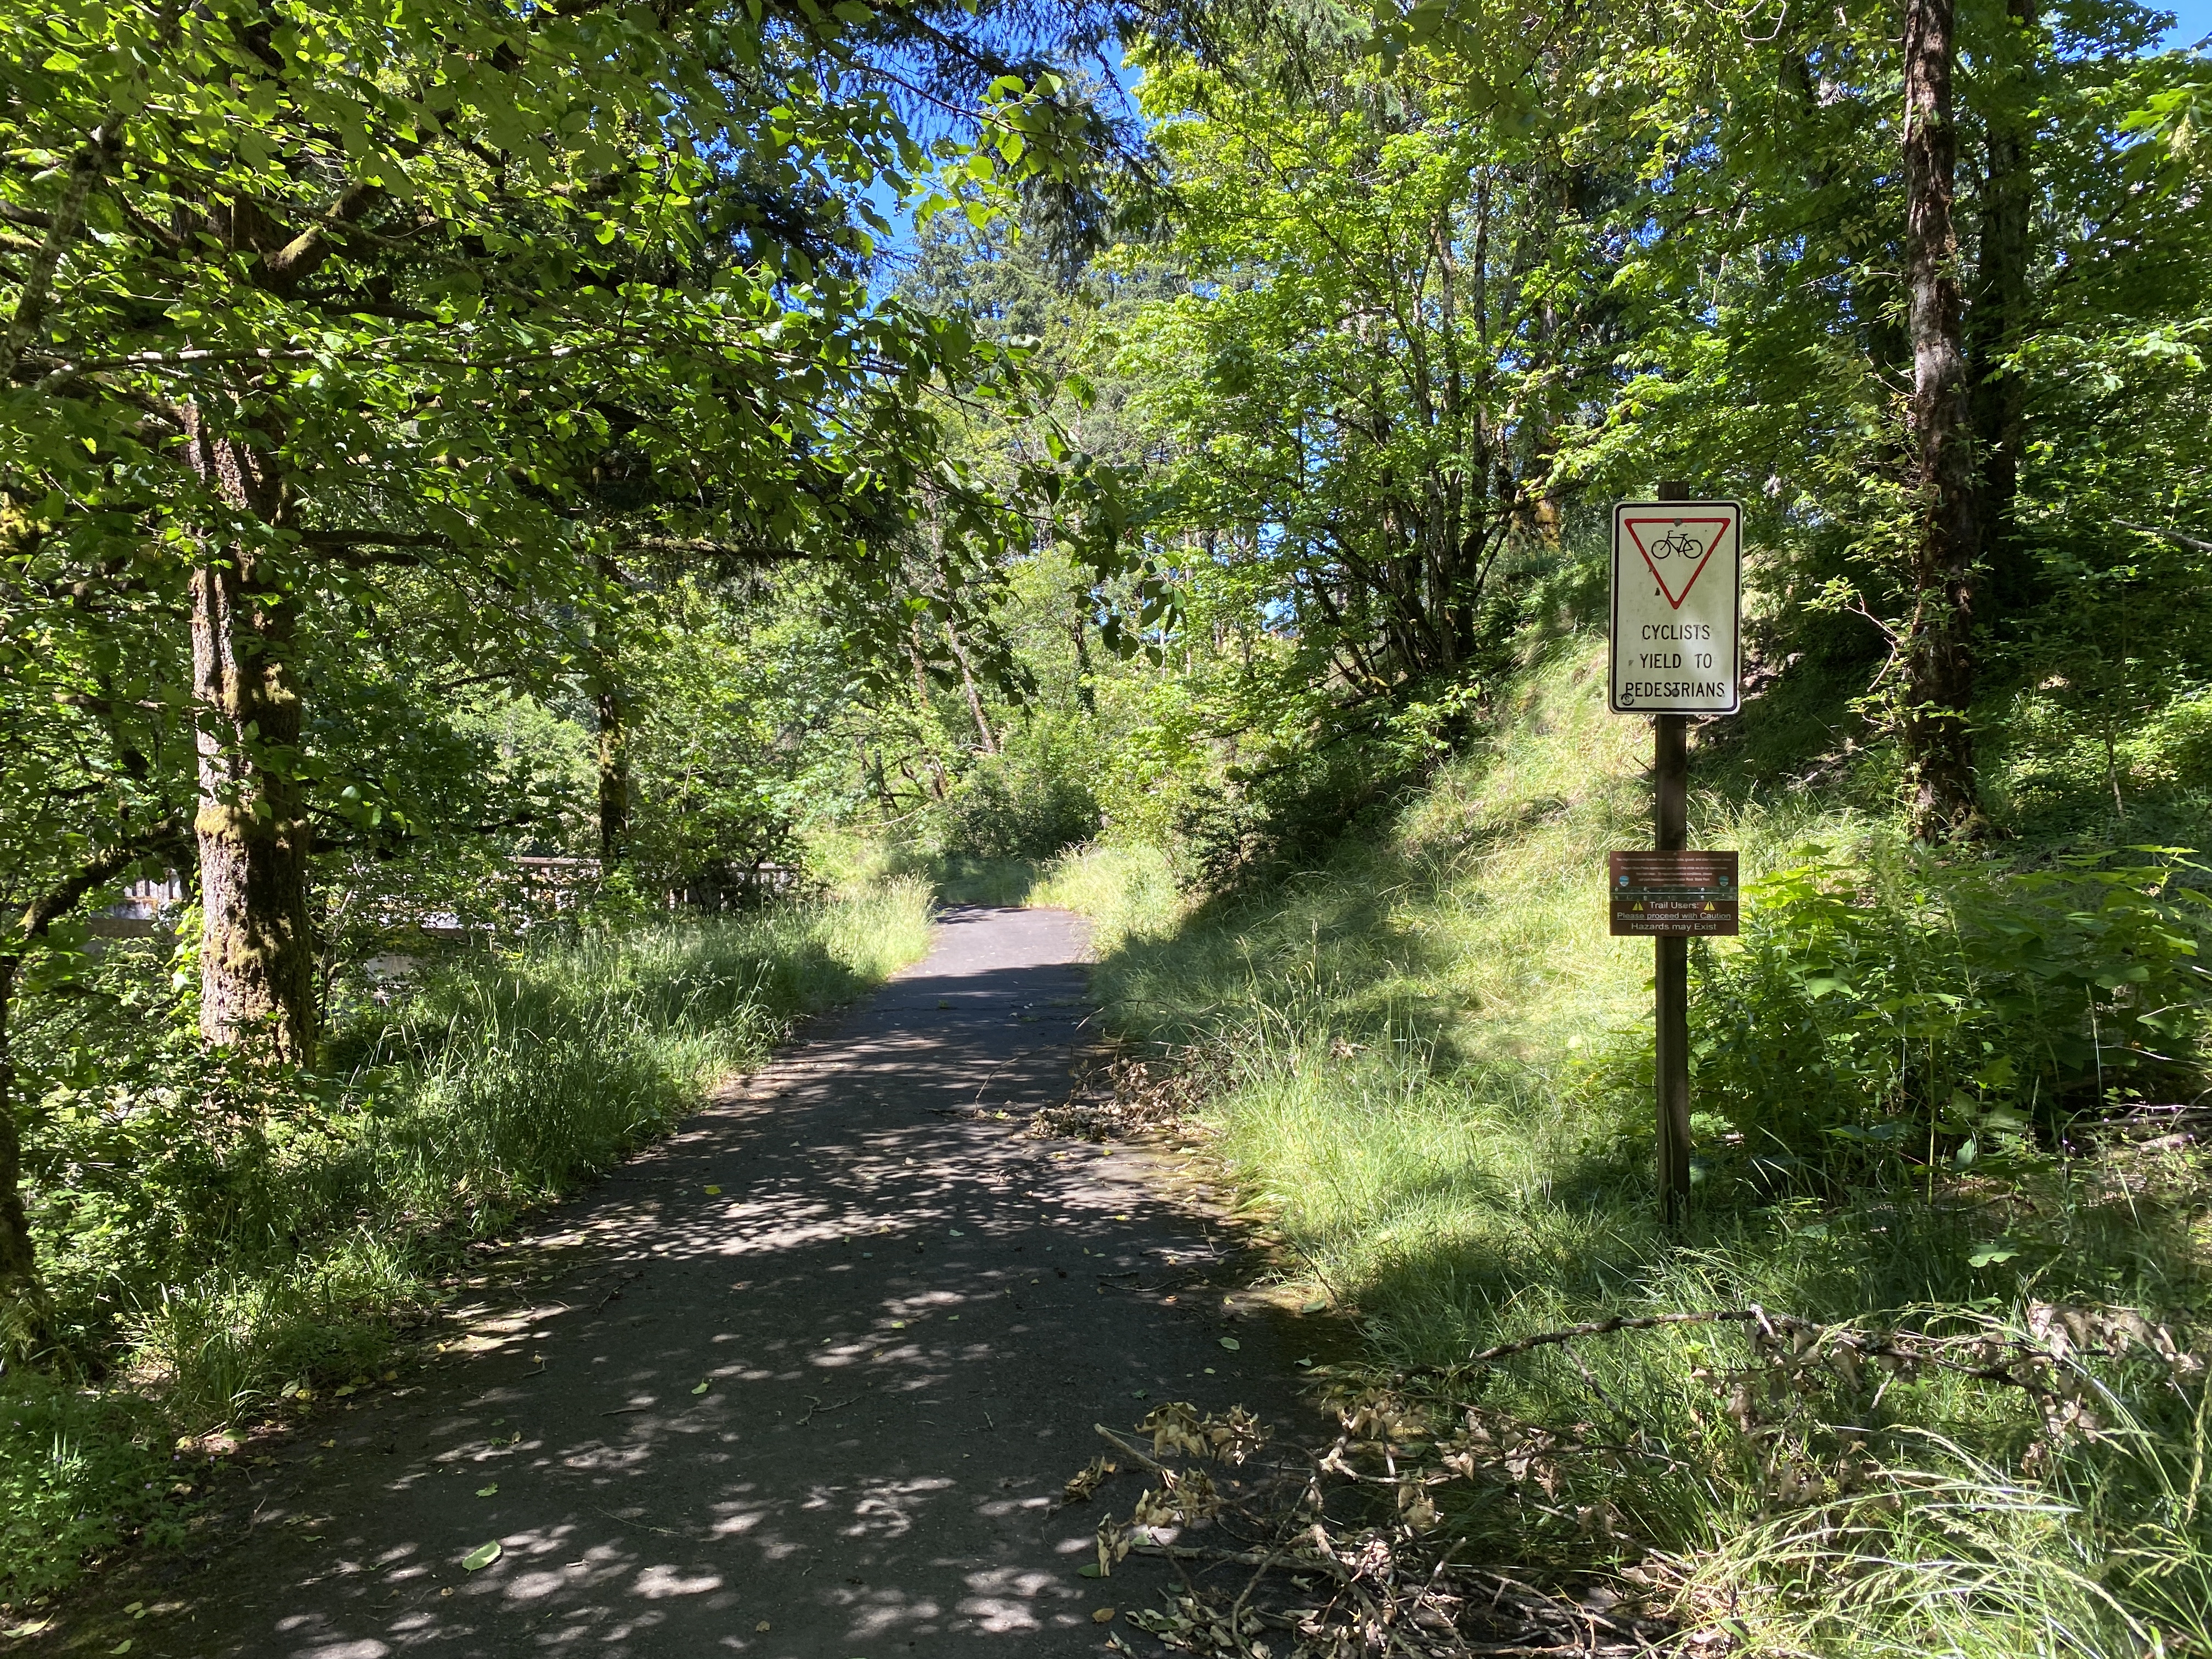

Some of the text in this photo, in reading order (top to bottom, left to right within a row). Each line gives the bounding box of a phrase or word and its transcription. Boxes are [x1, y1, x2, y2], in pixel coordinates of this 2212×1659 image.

[1642, 624, 1711, 640] CYCLISTS
[1639, 653, 1712, 668] YIELD TO
[1625, 682, 1725, 697] PEDESTRIANS
[1650, 901, 1699, 909] Trail Users:
